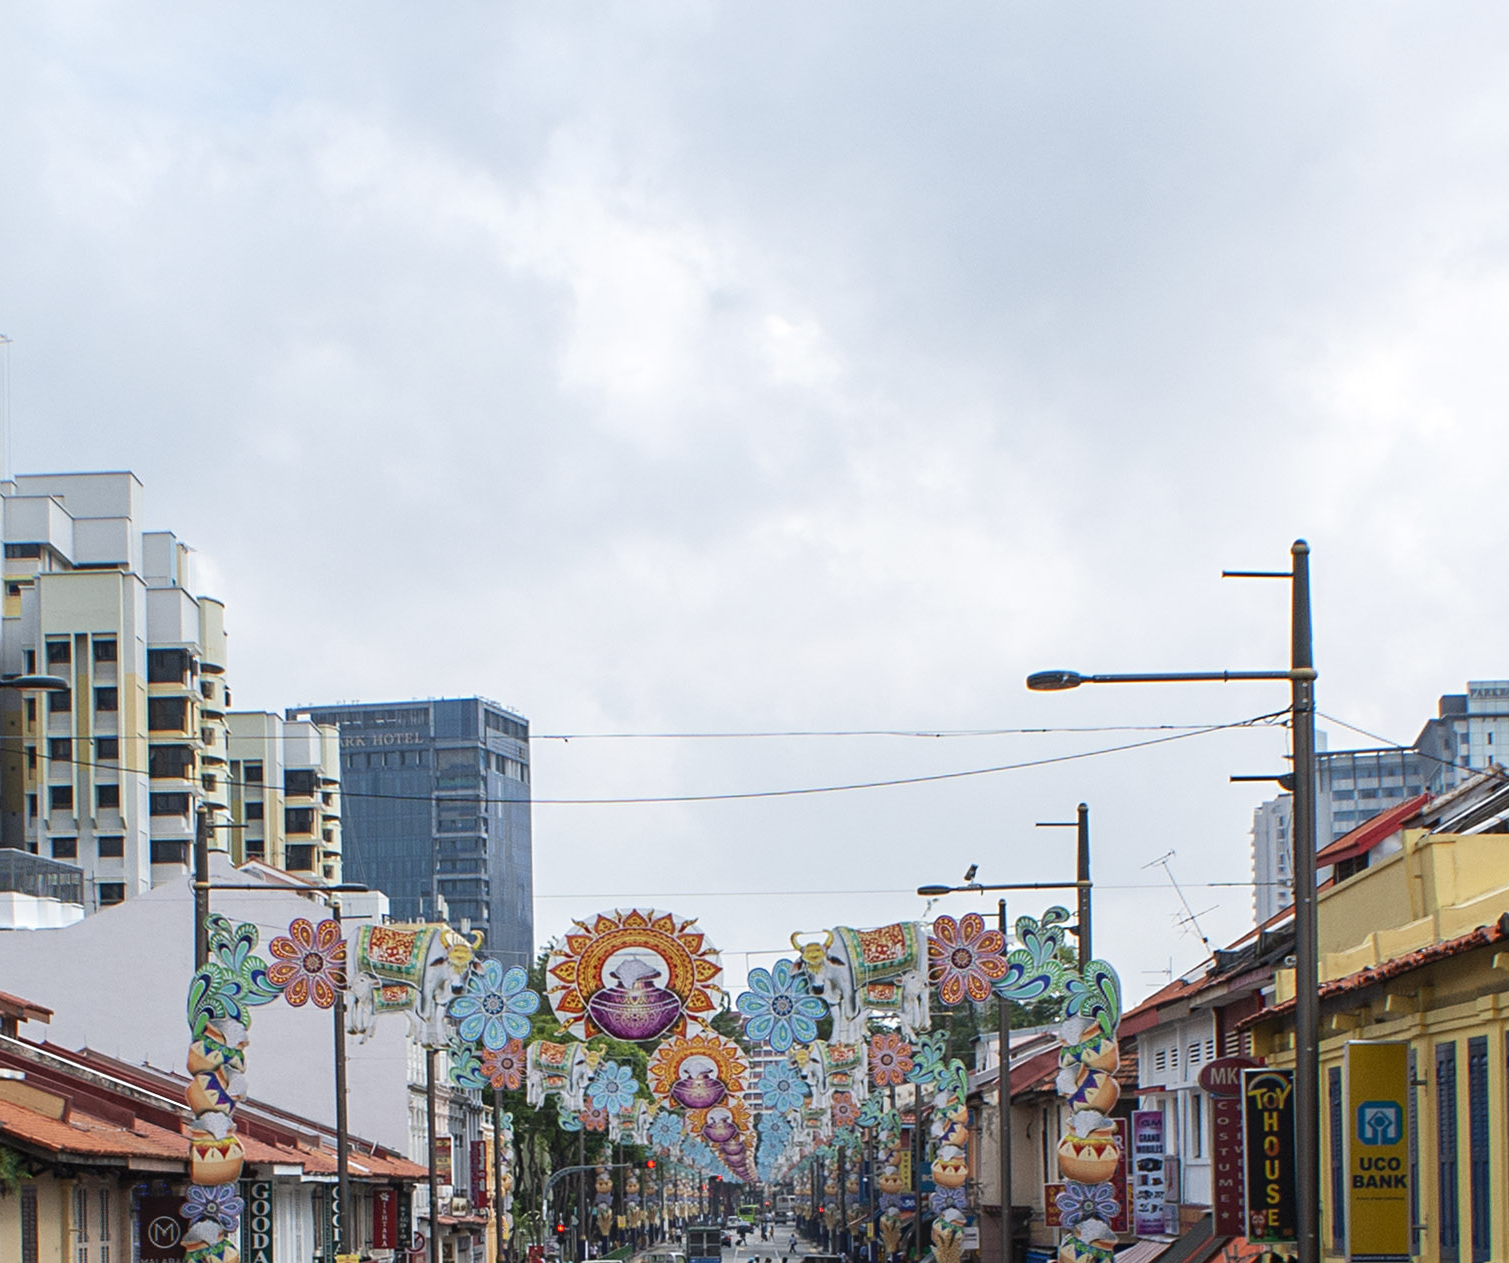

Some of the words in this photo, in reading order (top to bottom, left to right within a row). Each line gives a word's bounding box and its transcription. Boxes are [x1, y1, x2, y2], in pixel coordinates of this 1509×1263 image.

[1217, 1101, 1233, 1203] COSTUME
[1262, 1111, 1282, 1227] HOUSE
[1358, 1156, 1401, 1171] UCO
[1352, 1174, 1408, 1189] BANK
